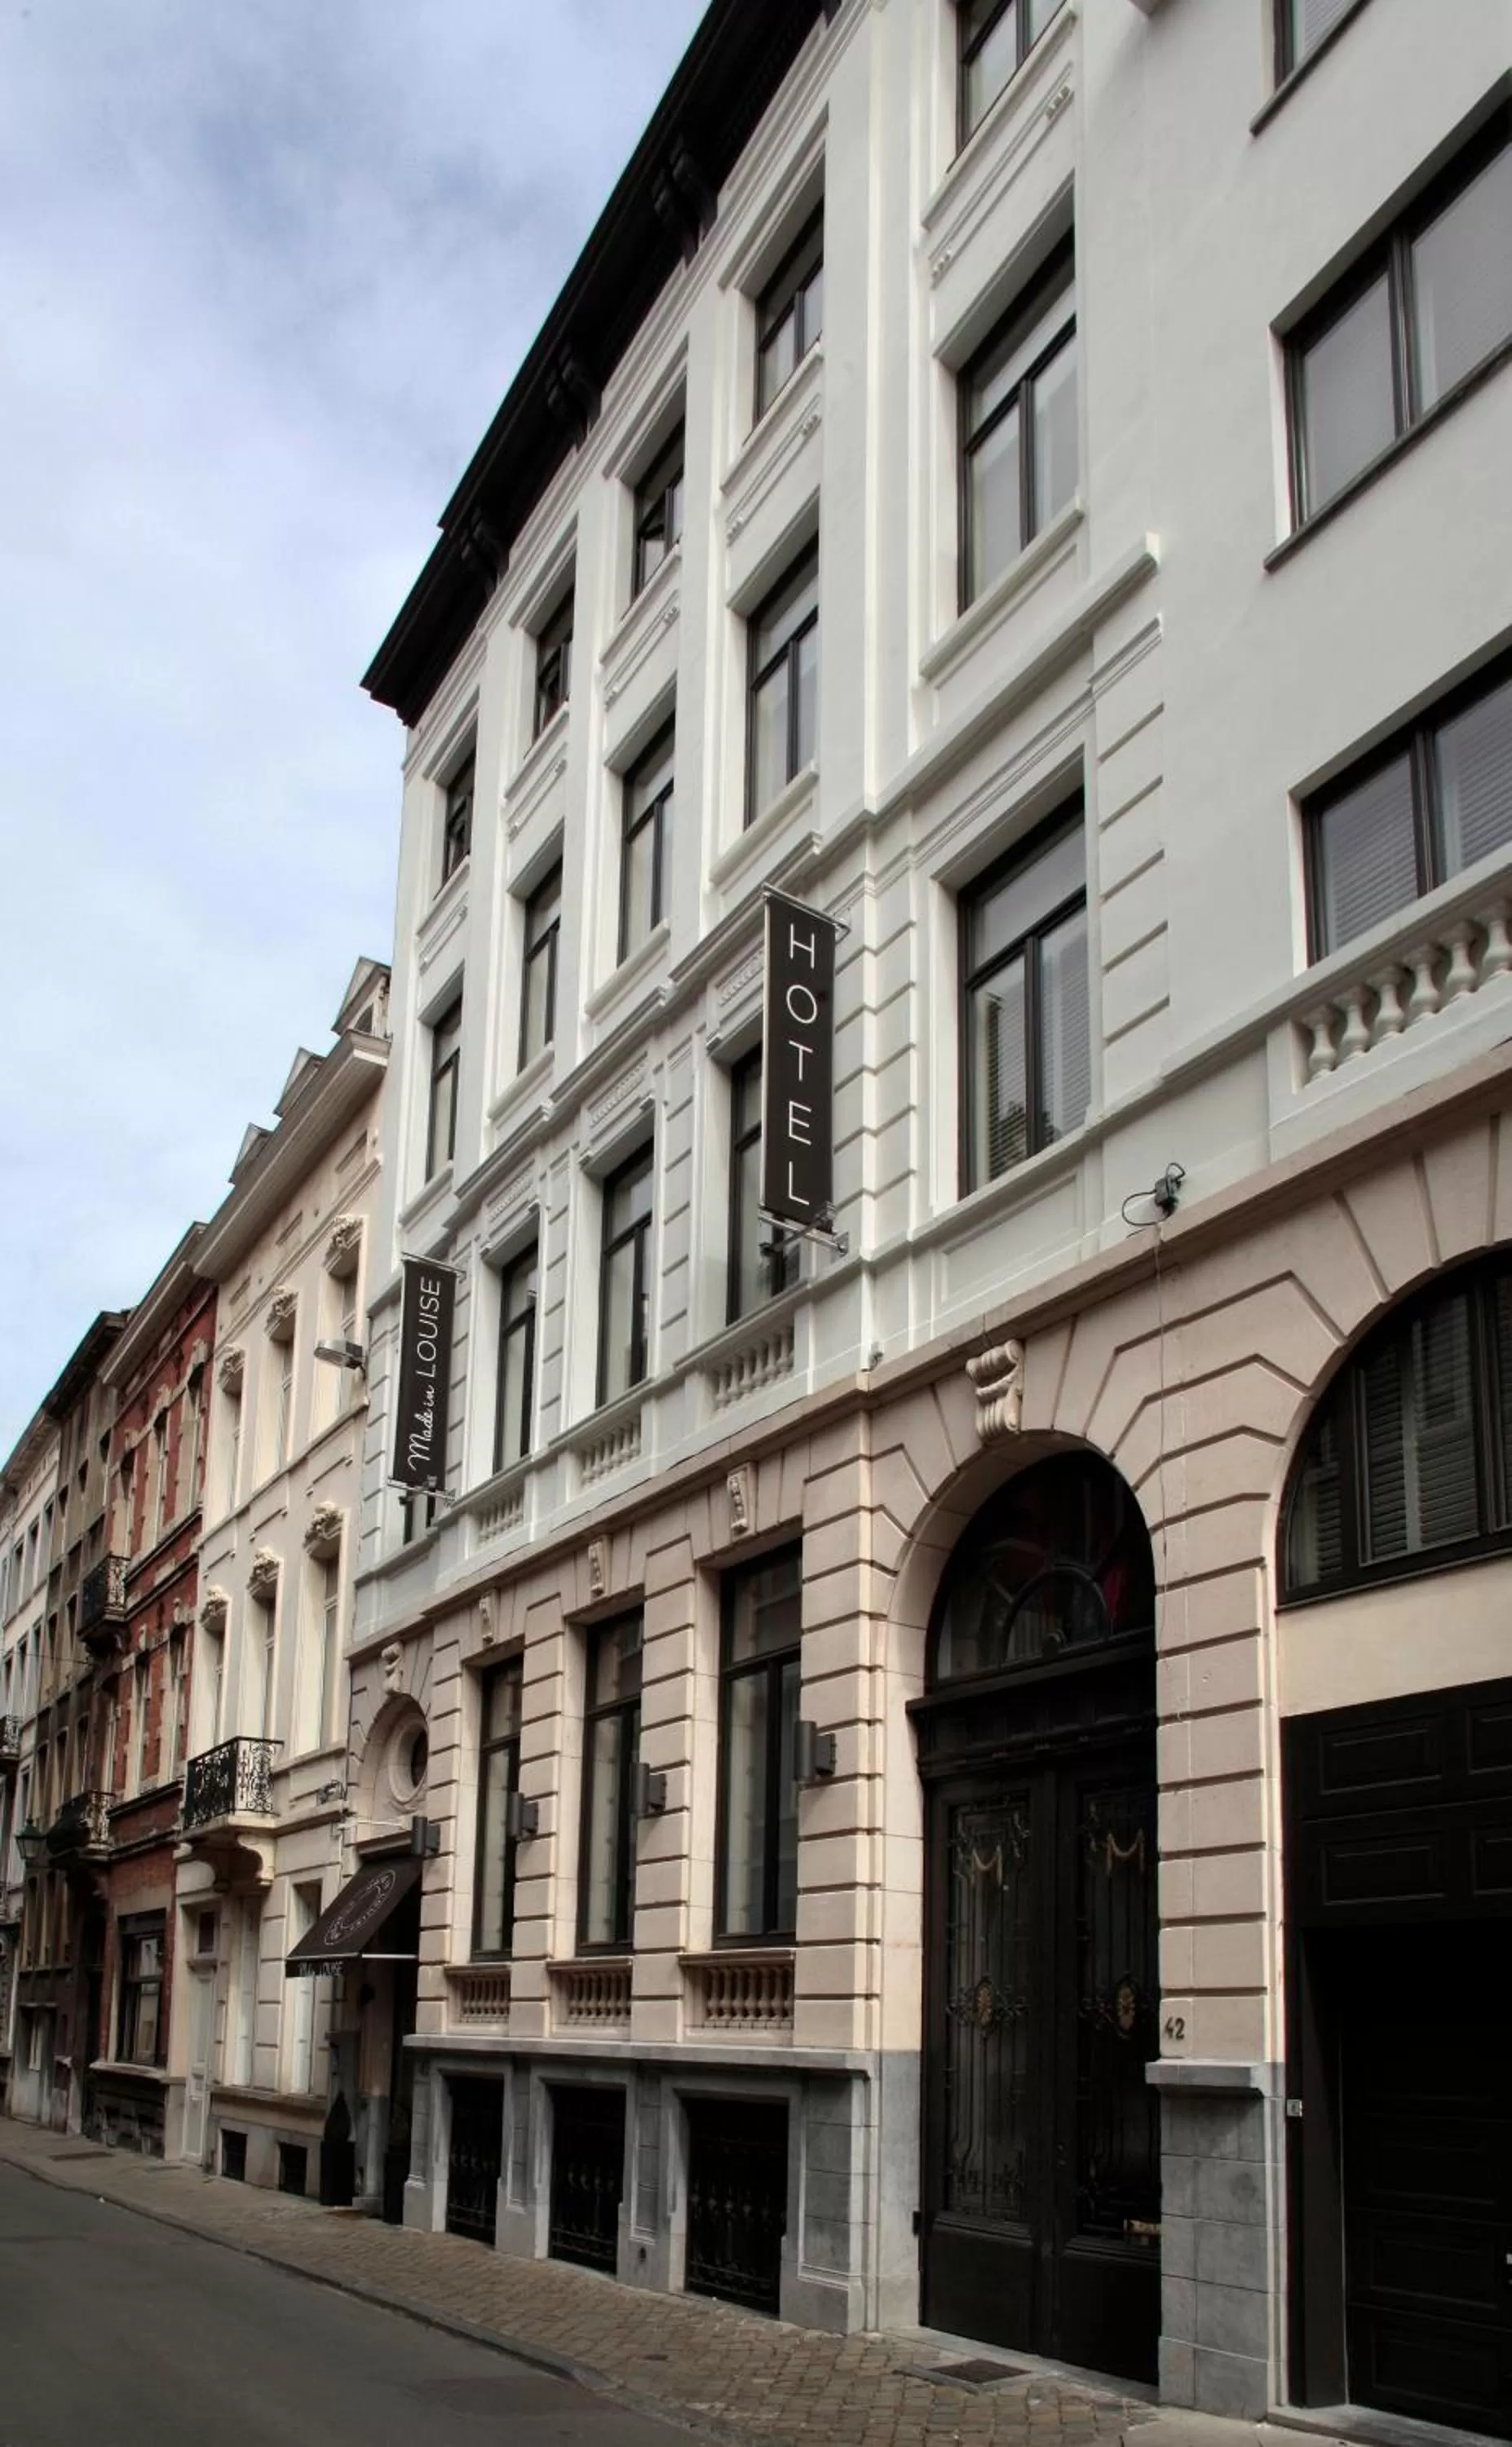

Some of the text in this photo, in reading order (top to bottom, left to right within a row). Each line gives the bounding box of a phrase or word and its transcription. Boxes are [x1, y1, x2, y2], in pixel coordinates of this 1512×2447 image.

[786, 923, 818, 1206] HOTEL
[407, 1276, 440, 1471] Made in LOUISE
[1165, 2016, 1185, 2040] 42
